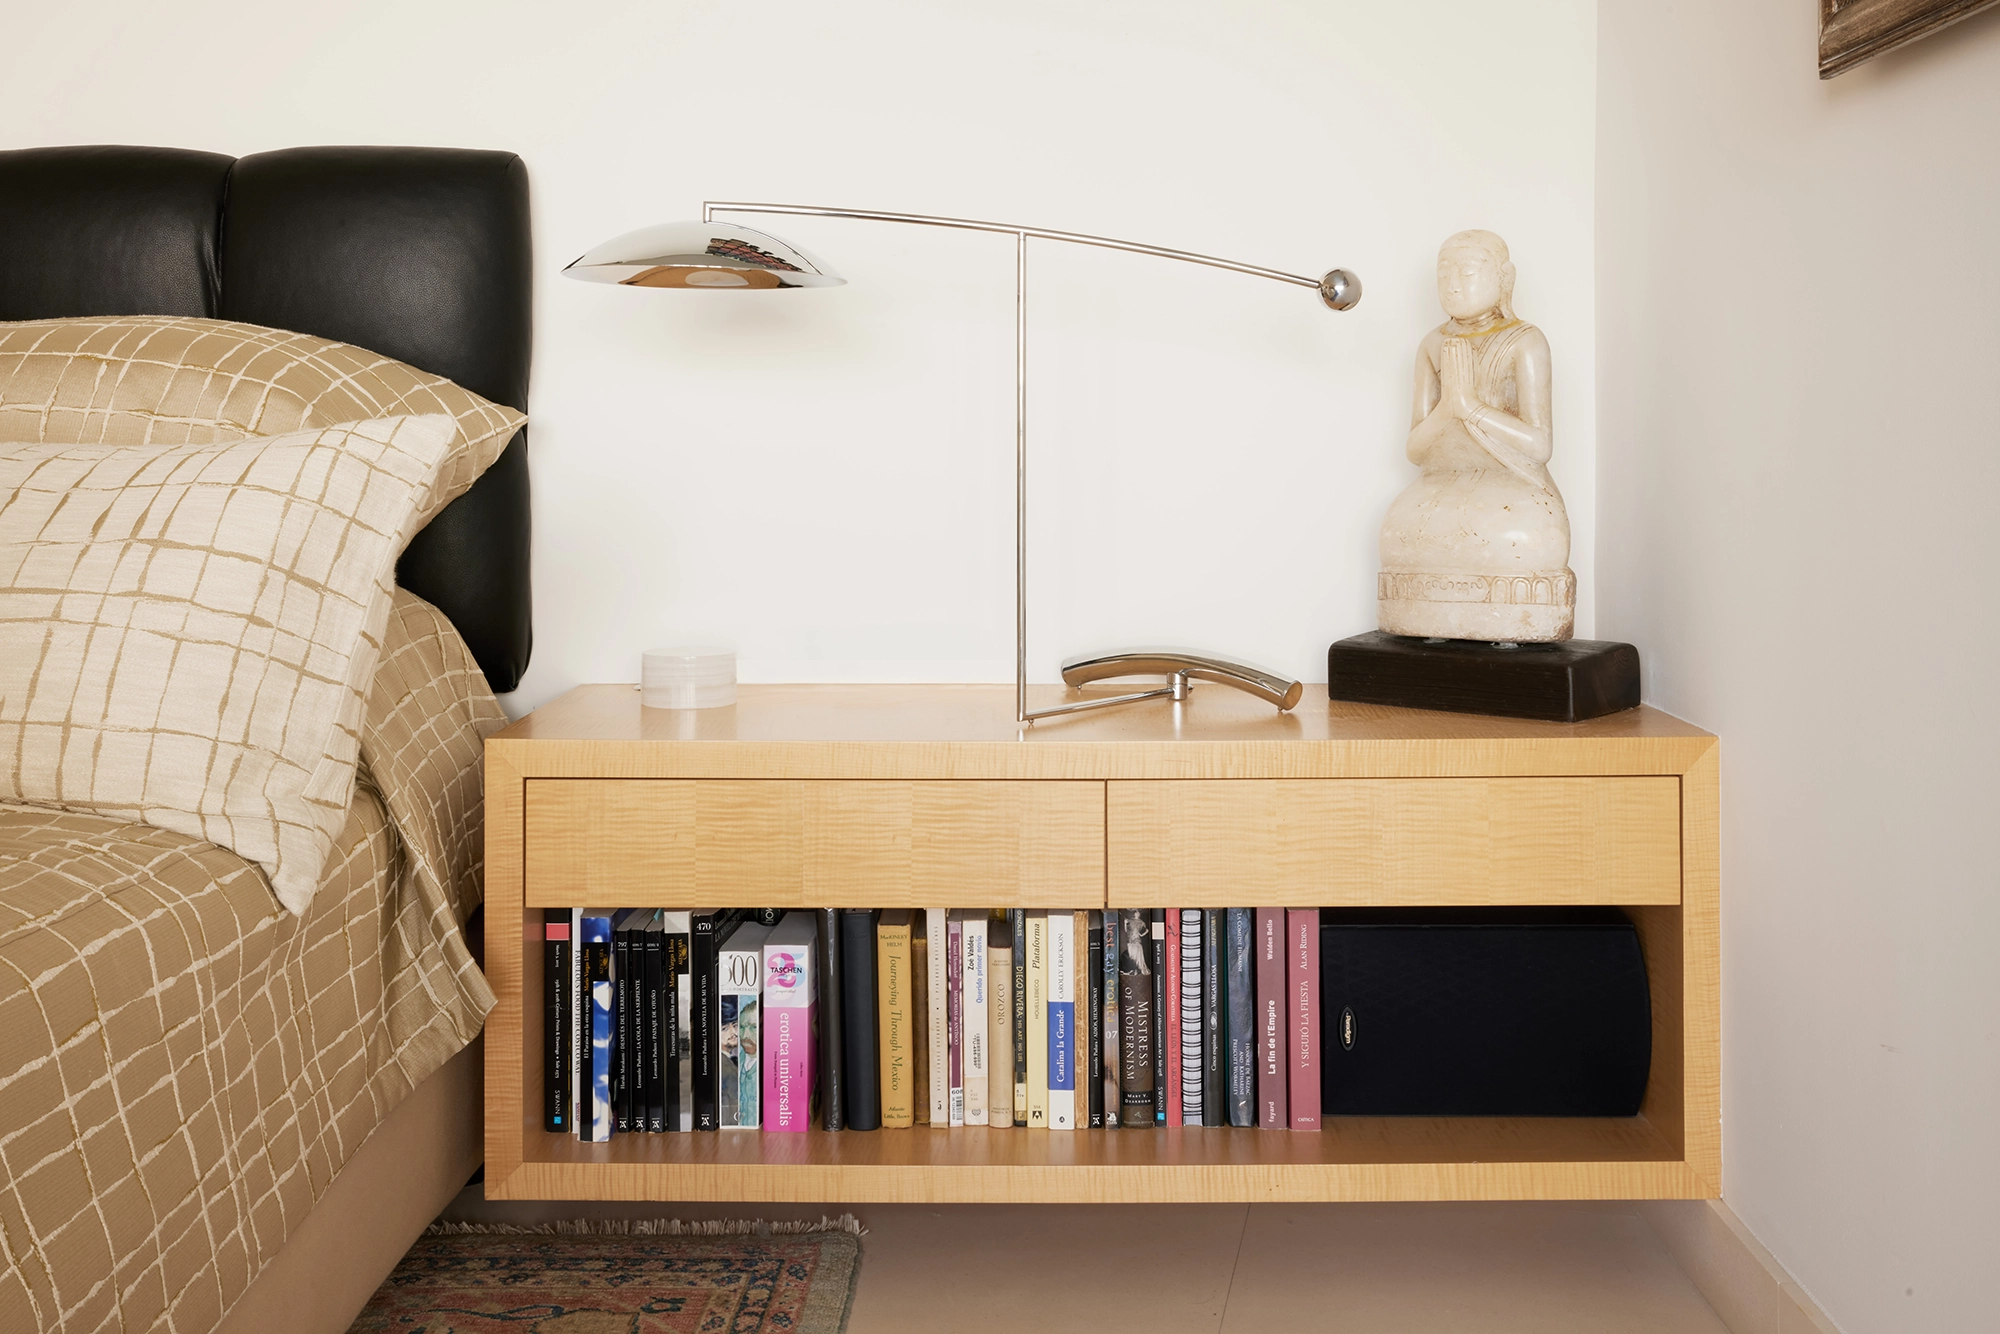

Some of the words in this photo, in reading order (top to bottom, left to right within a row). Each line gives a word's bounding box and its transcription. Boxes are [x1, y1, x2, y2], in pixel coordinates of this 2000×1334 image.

[697, 922, 711, 931] 470
[1106, 922, 1116, 948] best
[1032, 923, 1040, 969] Plataforma
[770, 966, 802, 974] TASCHEN
[1103, 953, 1115, 975] gay
[1300, 951, 1308, 970] ALAN
[888, 955, 901, 1006] Journeying
[1016, 966, 1024, 989] DIEGO
[701, 988, 707, 996] MI
[1107, 979, 1118, 1022] erotica
[1125, 987, 1132, 1001] OF
[1300, 980, 1309, 1011] FIESTA
[635, 1017, 641, 1025] DE
[652, 1010, 657, 1018] DE
[1056, 1010, 1065, 1039] Grande
[1301, 1013, 1309, 1025] LA
[780, 1012, 792, 1055] erotica
[891, 1010, 903, 1052] Through
[1106, 1031, 1118, 1039] 07
[1138, 1001, 1149, 1067] MISTRESS
[1171, 1023, 1176, 1031] EL
[1125, 1005, 1135, 1080] MODERNISM
[1267, 1038, 1275, 1049] de
[1299, 1027, 1309, 1060] SIGUIÓ
[1055, 1050, 1065, 1083] Catalina
[1267, 1050, 1276, 1062] fin
[891, 1055, 903, 1090] Mexico
[1268, 1064, 1276, 1074] La
[779, 1058, 792, 1126] universalis
[1268, 1101, 1276, 1122] fayard
